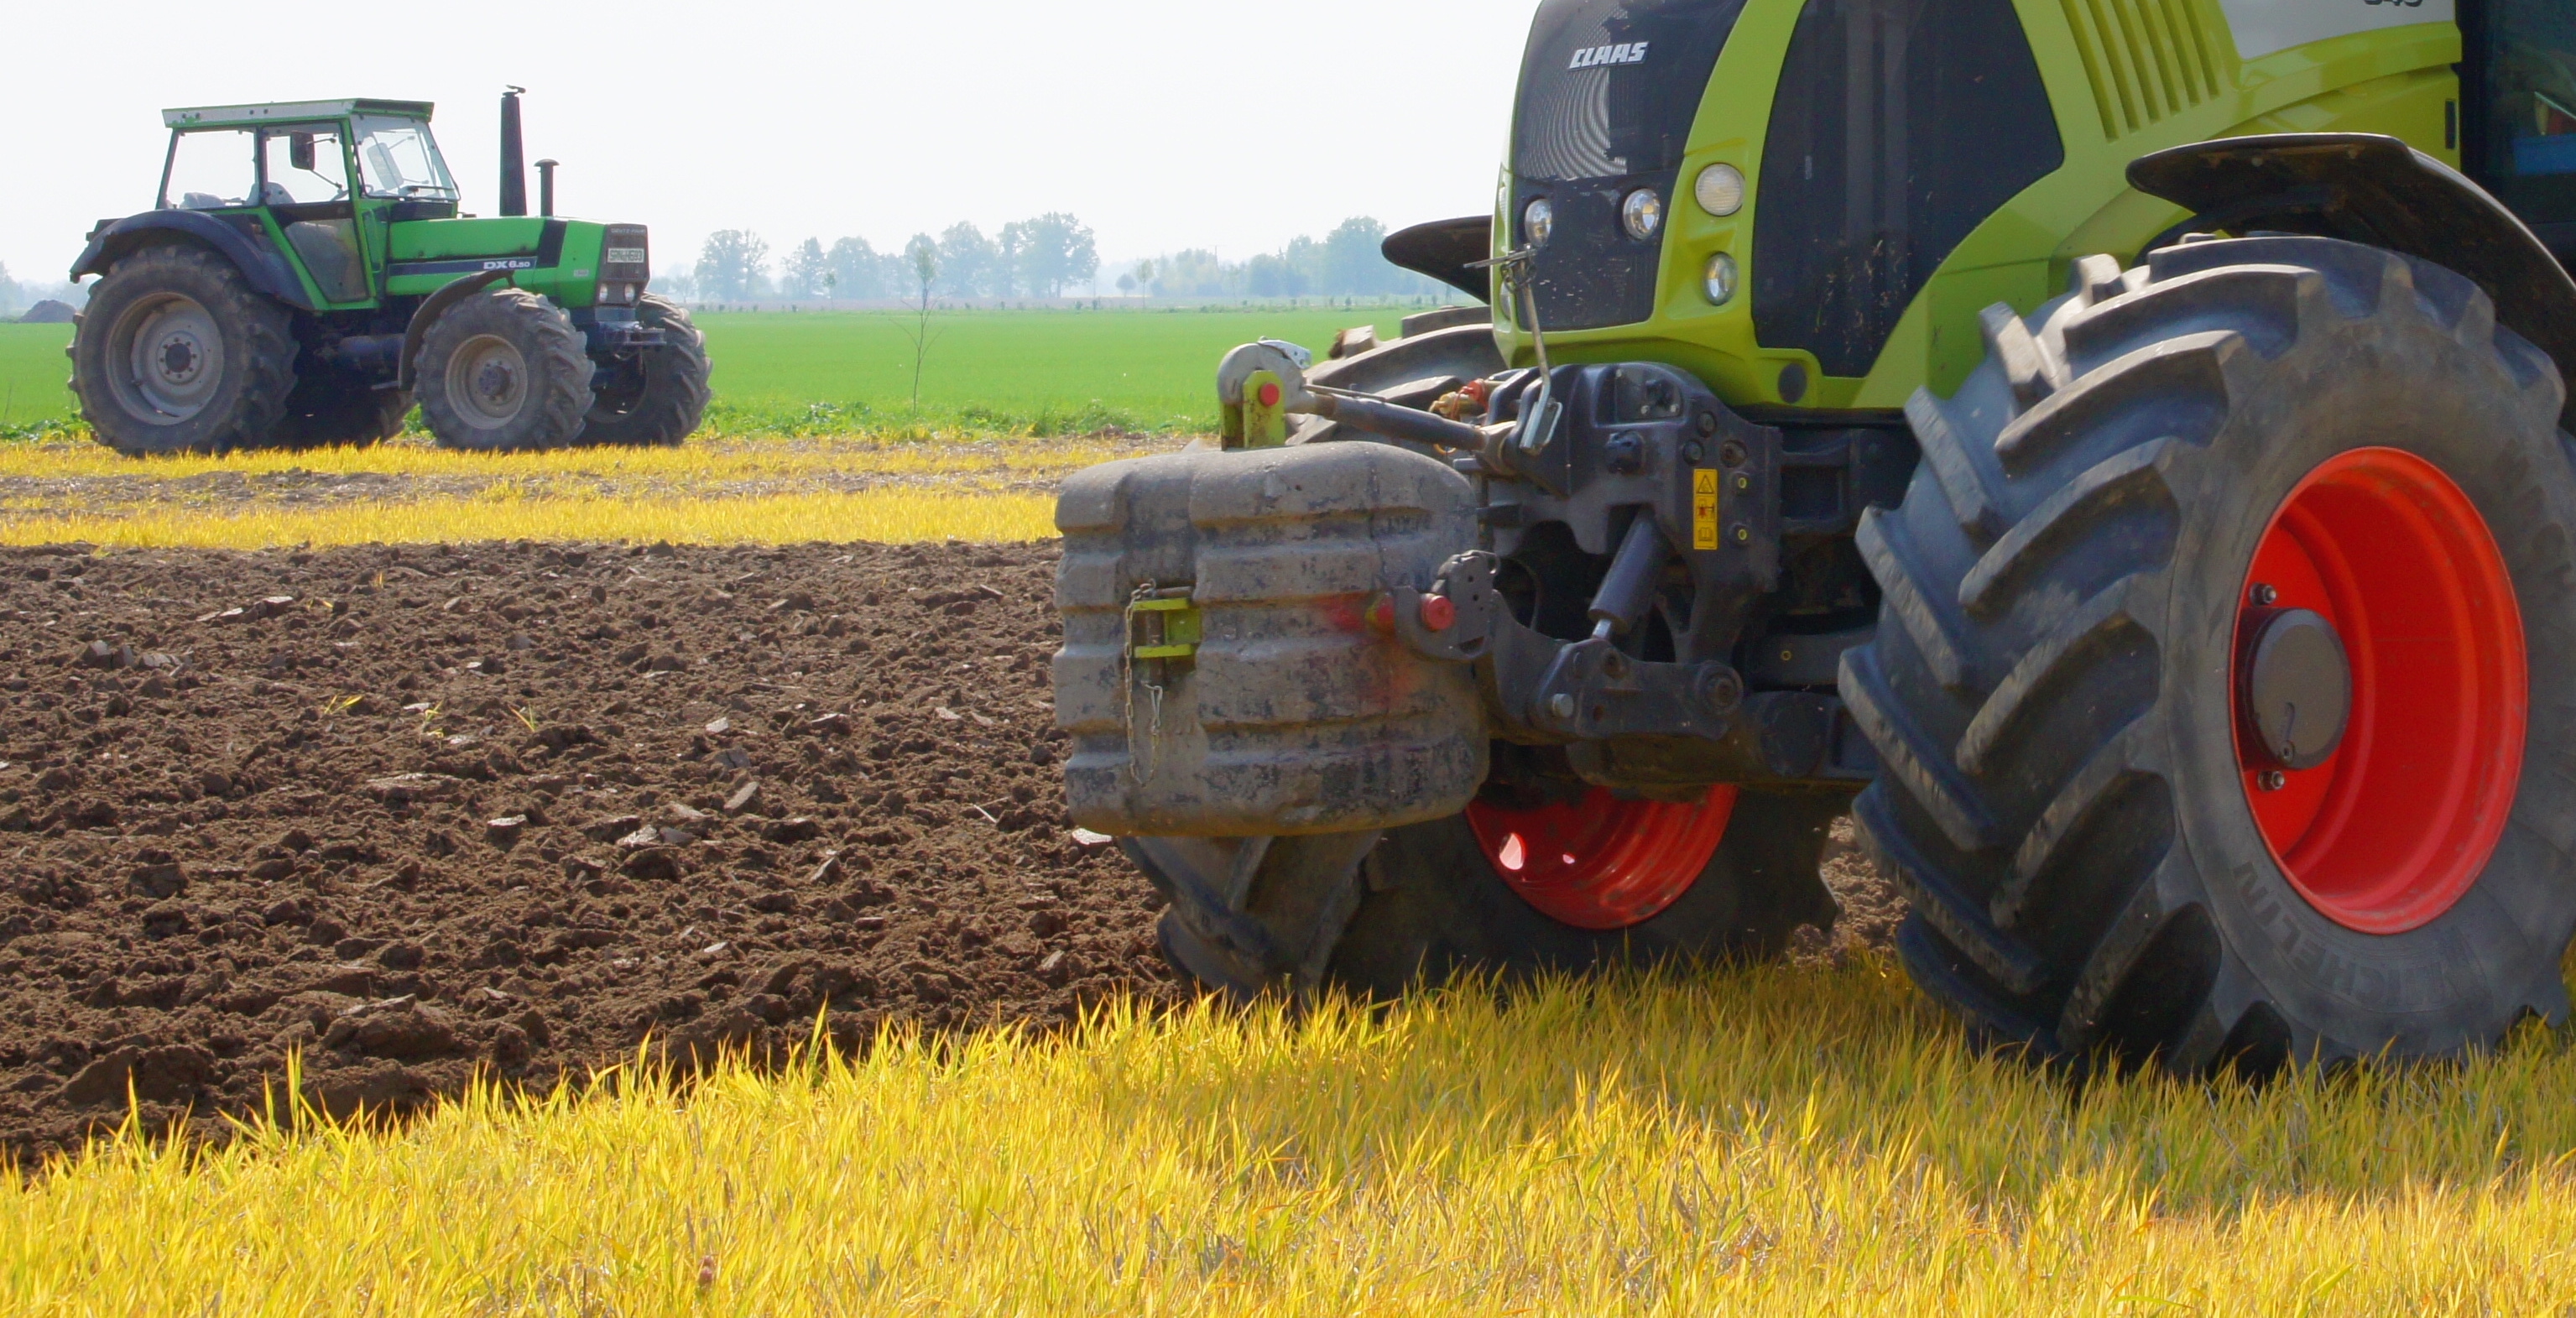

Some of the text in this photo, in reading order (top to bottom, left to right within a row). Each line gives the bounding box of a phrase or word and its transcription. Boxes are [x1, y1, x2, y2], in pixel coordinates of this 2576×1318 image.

[1569, 41, 1649, 69] CLAAS
[483, 260, 530, 269] DX 6.50
[2232, 861, 2447, 1008] MICHELIN
